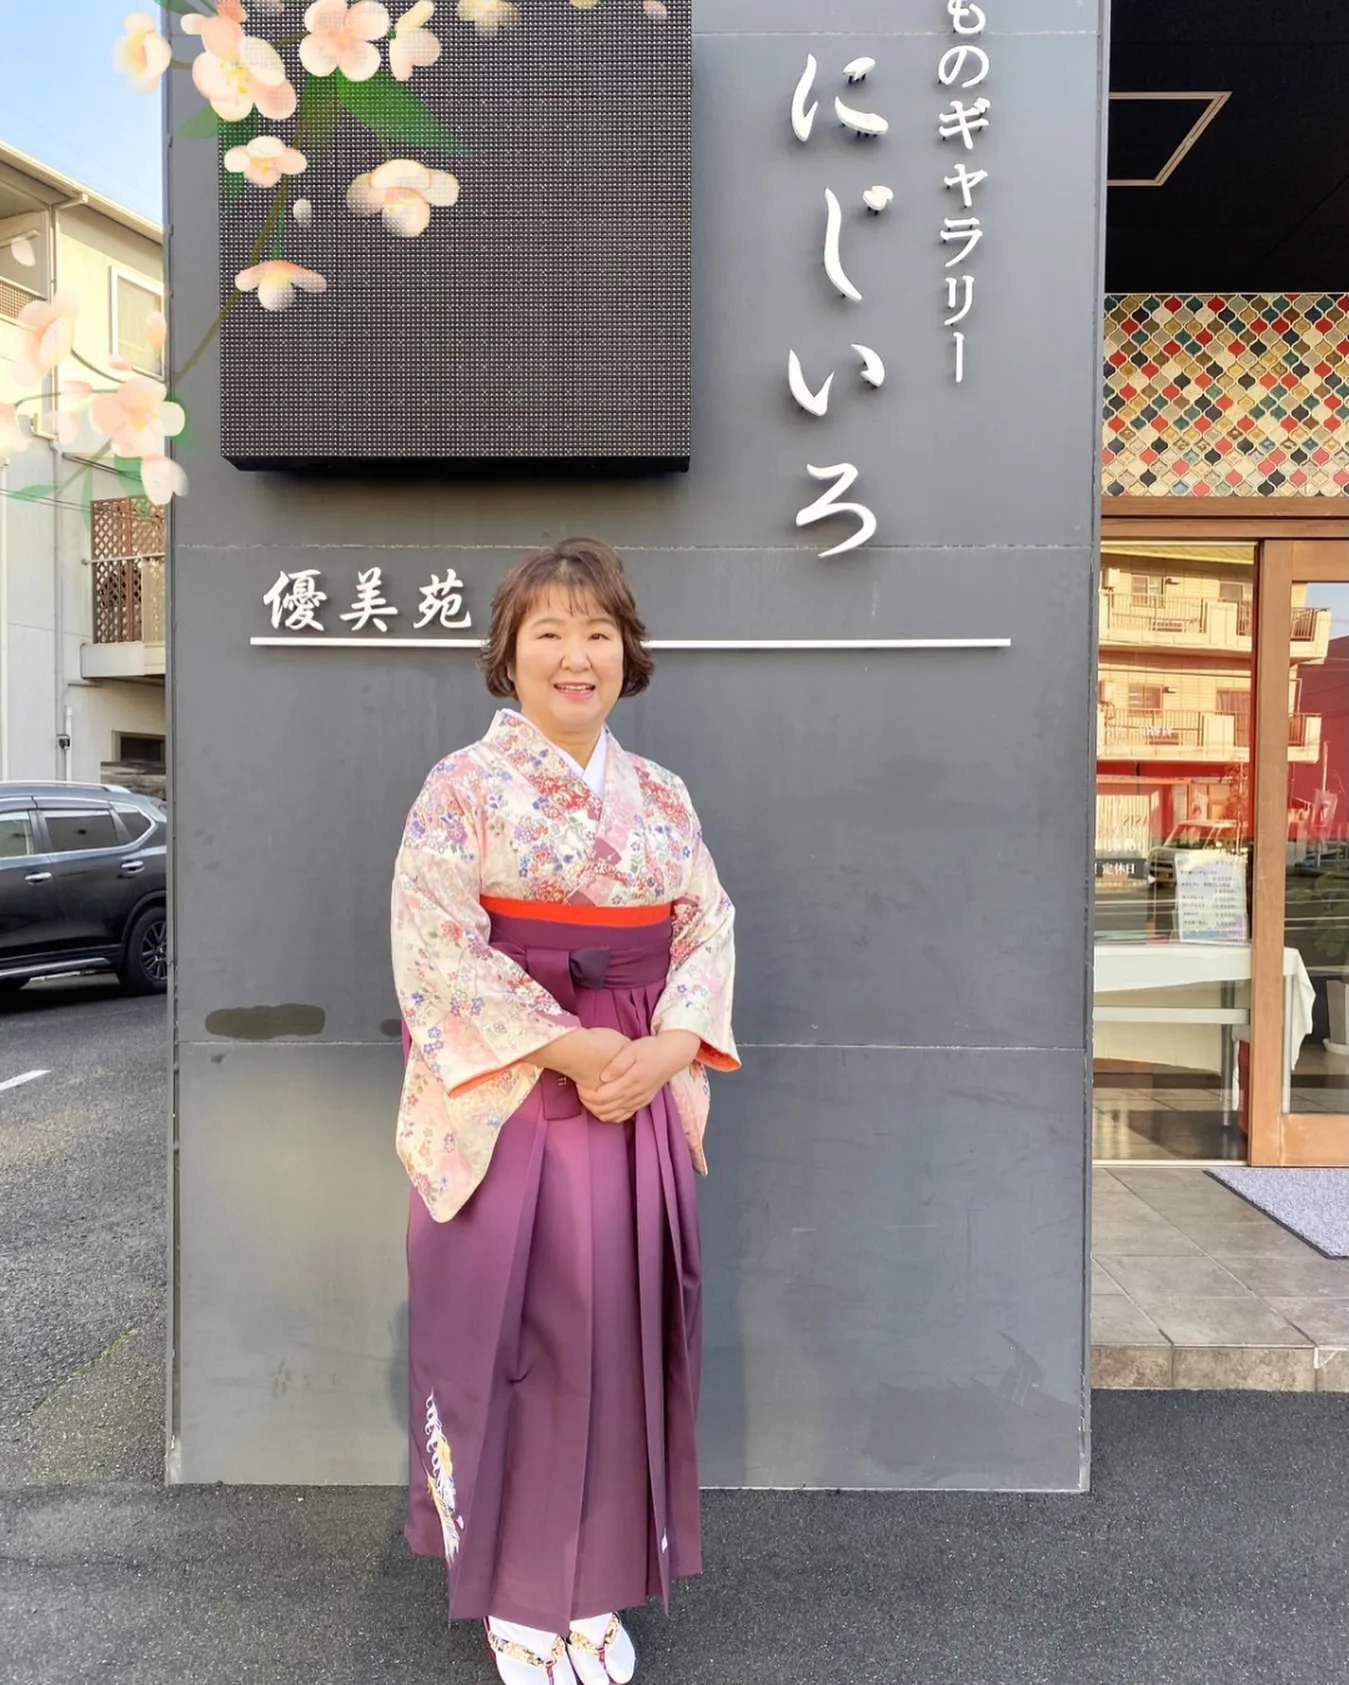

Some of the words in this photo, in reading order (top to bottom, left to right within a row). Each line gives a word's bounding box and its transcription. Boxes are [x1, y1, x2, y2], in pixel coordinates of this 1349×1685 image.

[788, 53, 894, 558] にじいろ
[938, 0, 991, 383] ものギャラリー
[263, 566, 473, 632] 優美苑
